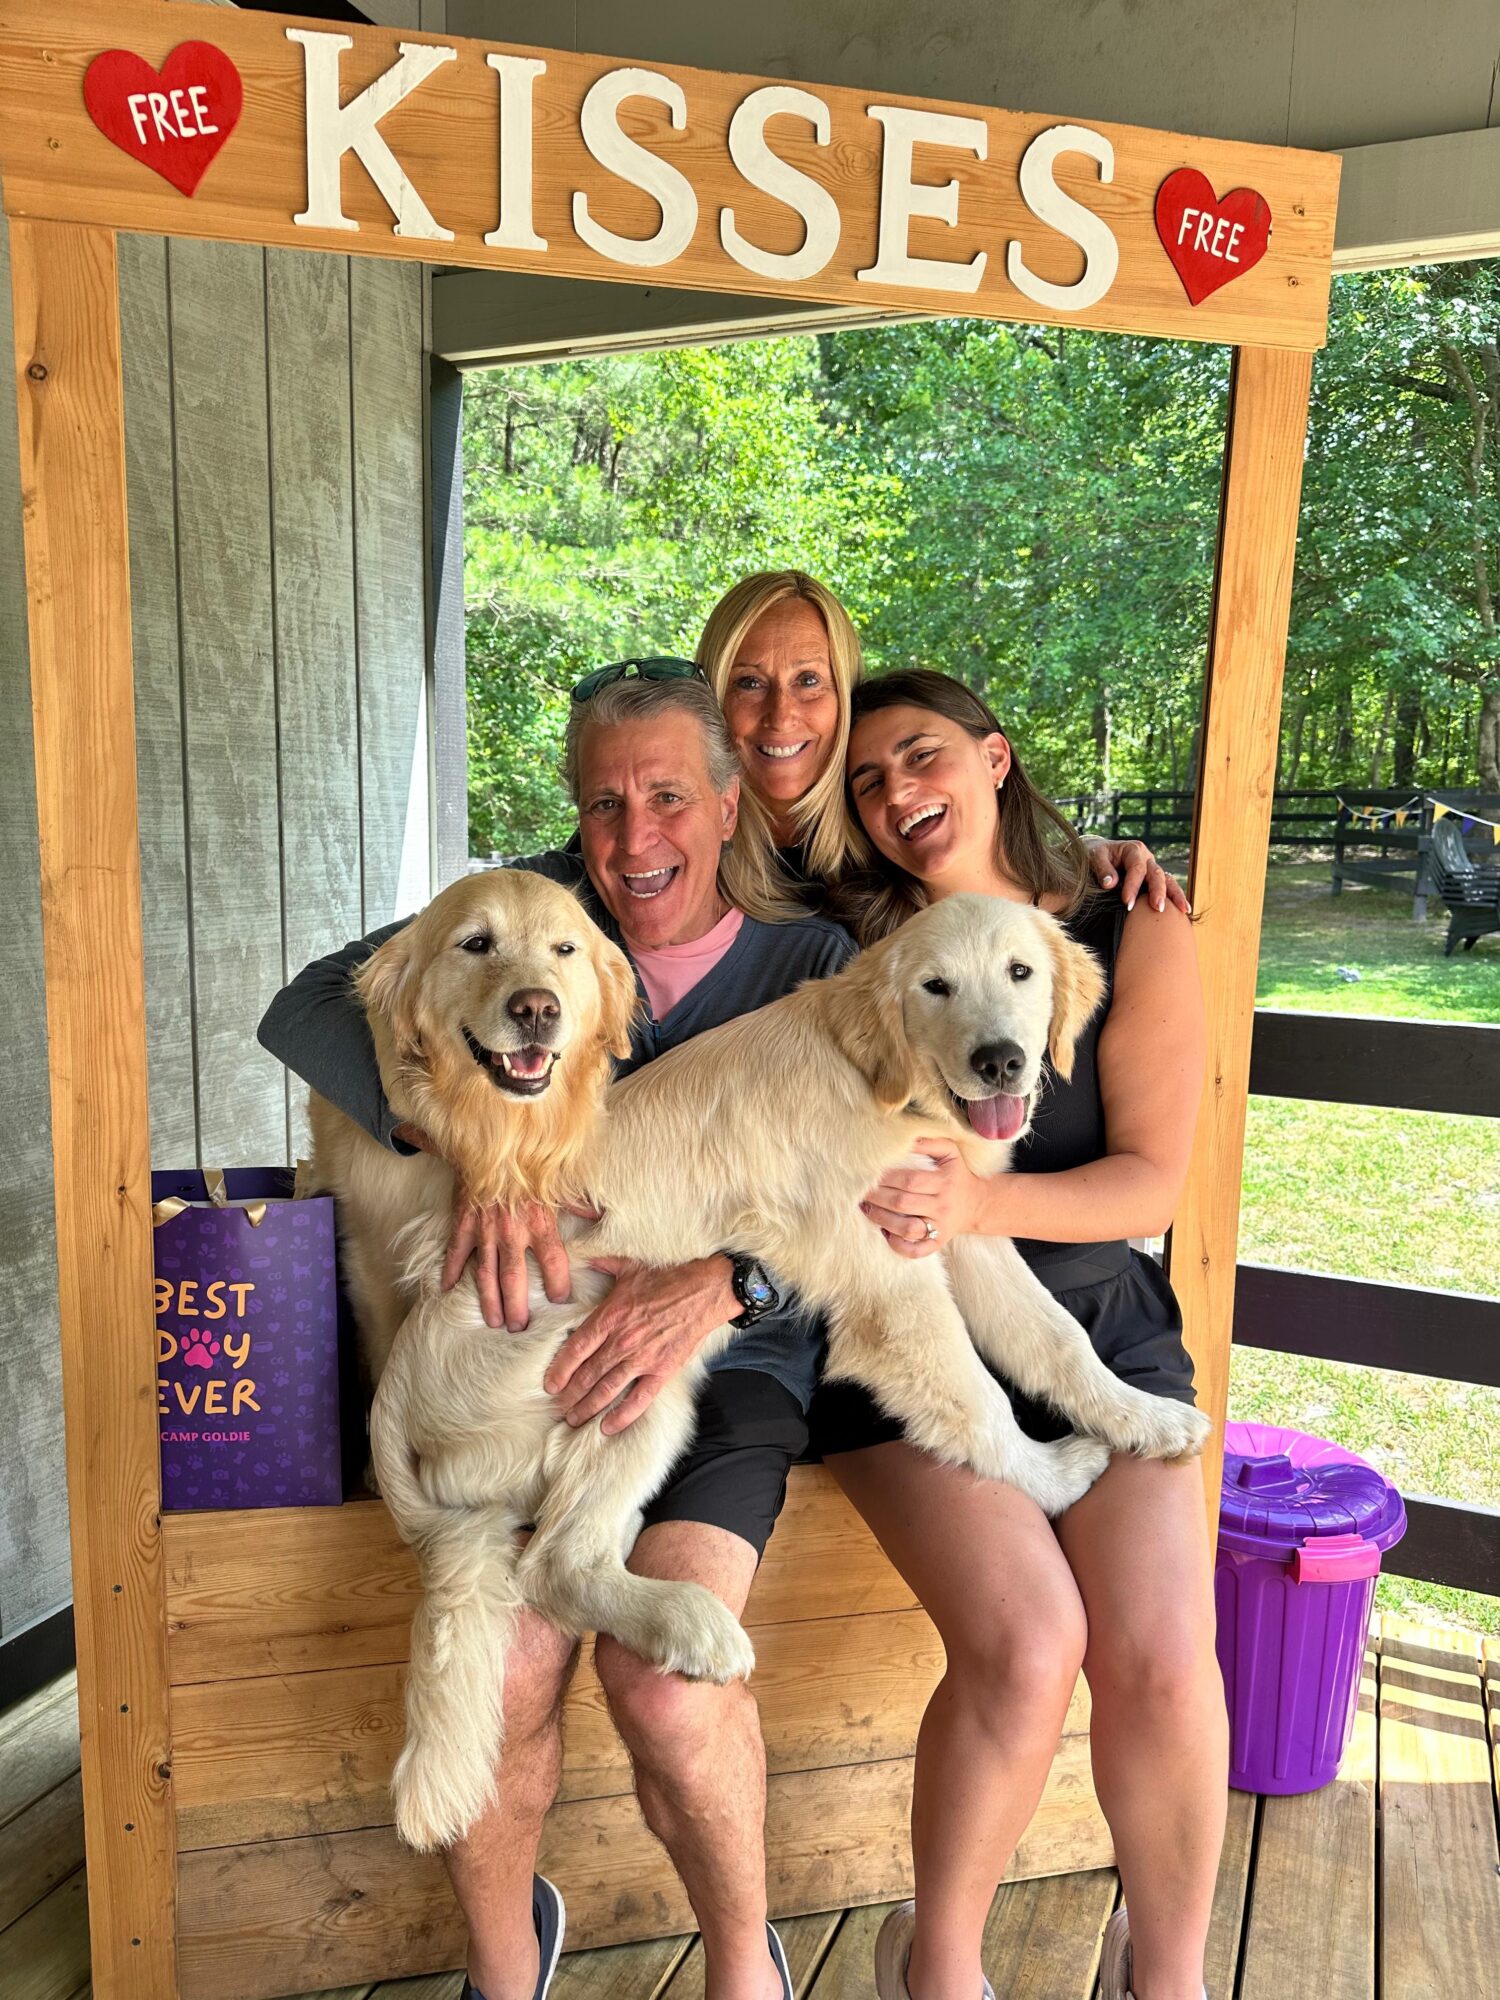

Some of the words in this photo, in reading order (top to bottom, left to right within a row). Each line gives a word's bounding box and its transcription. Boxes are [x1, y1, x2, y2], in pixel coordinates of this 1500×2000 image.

[127, 86, 218, 145] FREE
[285, 27, 1120, 312] KISSES
[1176, 208, 1244, 263] FREE
[155, 1278, 256, 1319] BEST
[160, 1432, 199, 1442] CAMP
[202, 1432, 250, 1442] GOLDIE
